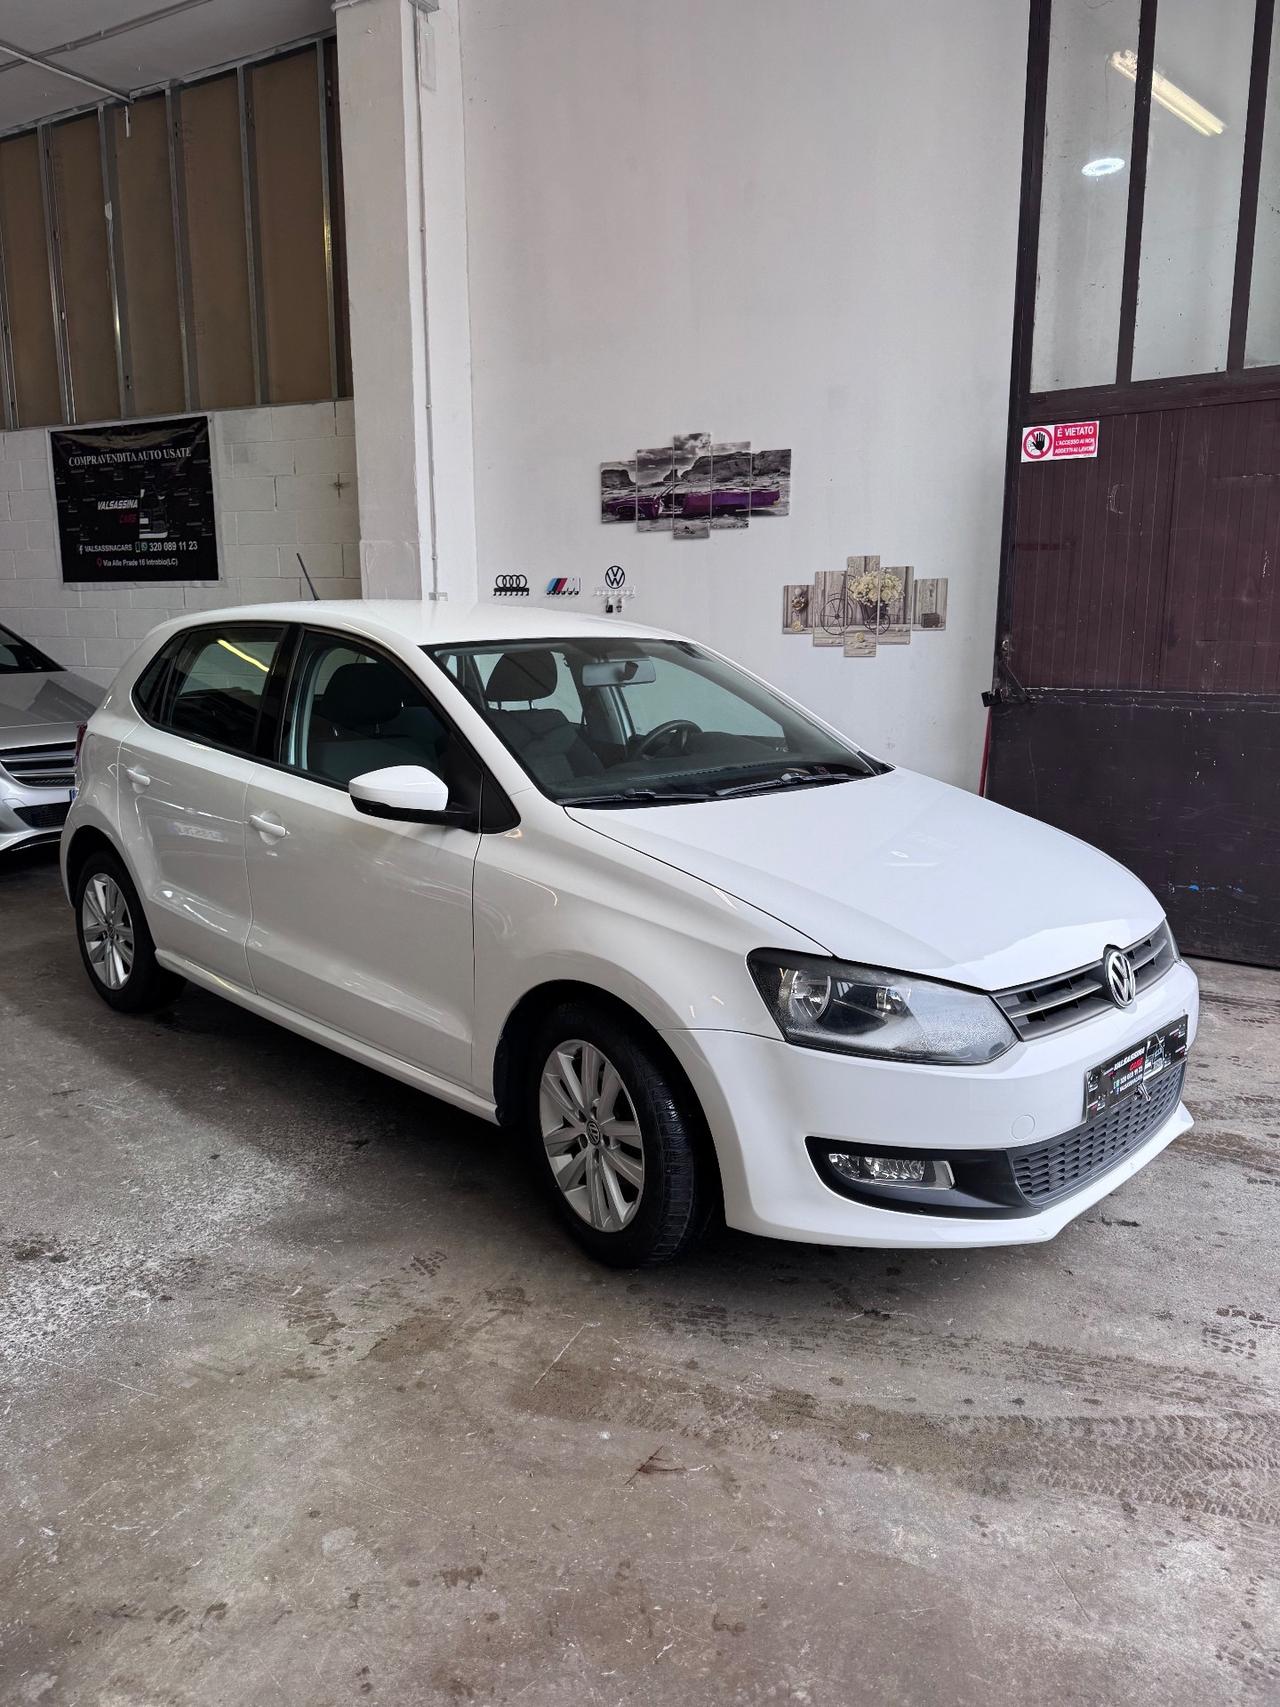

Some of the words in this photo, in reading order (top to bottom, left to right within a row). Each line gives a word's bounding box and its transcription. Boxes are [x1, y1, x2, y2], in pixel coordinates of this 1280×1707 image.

[1064, 426, 1094, 436] VIETATO
[69, 452, 136, 466] COMPRAVENDITA
[136, 450, 162, 462] AUTO
[163, 447, 192, 459] USATE
[97, 499, 139, 510] VALSASSINA
[149, 542, 162, 551] 320
[178, 541, 187, 550] 11
[188, 540, 198, 550] 23
